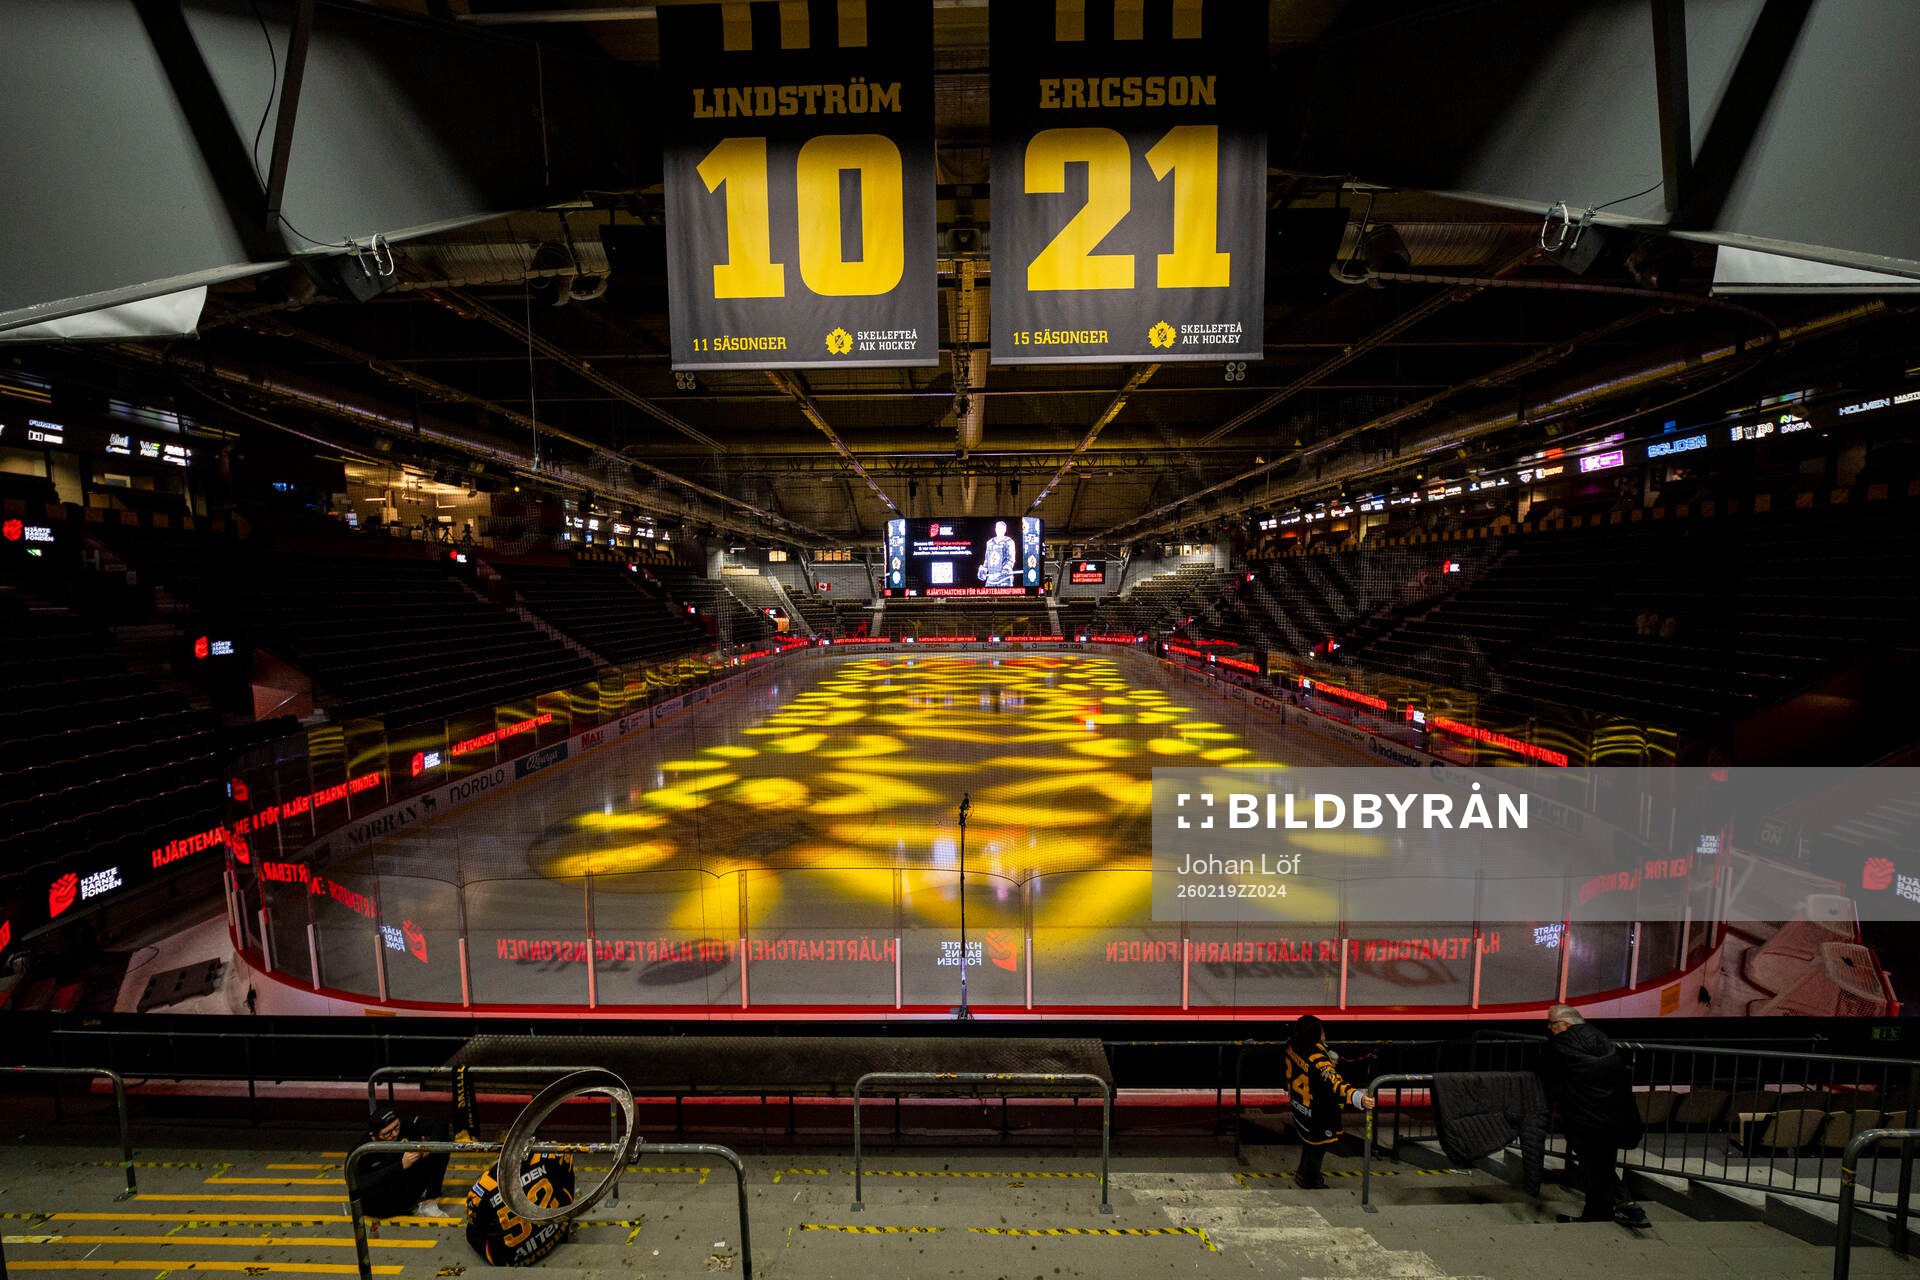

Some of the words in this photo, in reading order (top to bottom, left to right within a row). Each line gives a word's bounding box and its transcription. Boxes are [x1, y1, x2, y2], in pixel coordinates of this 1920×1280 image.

[692, 77, 902, 118] LINDSTRÖM
[1039, 75, 1217, 109] ERICSSON
[696, 134, 905, 300] 10
[1024, 125, 1231, 292] 21
[857, 328, 918, 341] SKELLEFTEÅ
[1012, 331, 1030, 346] 15
[1032, 328, 1109, 346] SÄSONGER
[1180, 322, 1243, 334] SKELLEFTEÅ
[692, 337, 709, 352] 11
[712, 335, 788, 352] SÄSONGER
[859, 341, 875, 351] AIK
[879, 339, 917, 351] HOCKEY
[1182, 335, 1198, 345] AIK
[1202, 333, 1241, 345] HOCKEY
[1839, 398, 1891, 415] HOLMEN
[1647, 434, 1707, 458] BOLIDEN
[1254, 696, 1280, 712] CCM
[152, 813, 260, 869] HJÄRTEMATHEN
[81, 866, 119, 886] HJÄRTE
[81, 876, 116, 893] BARNS
[82, 879, 122, 900] FONDEN
